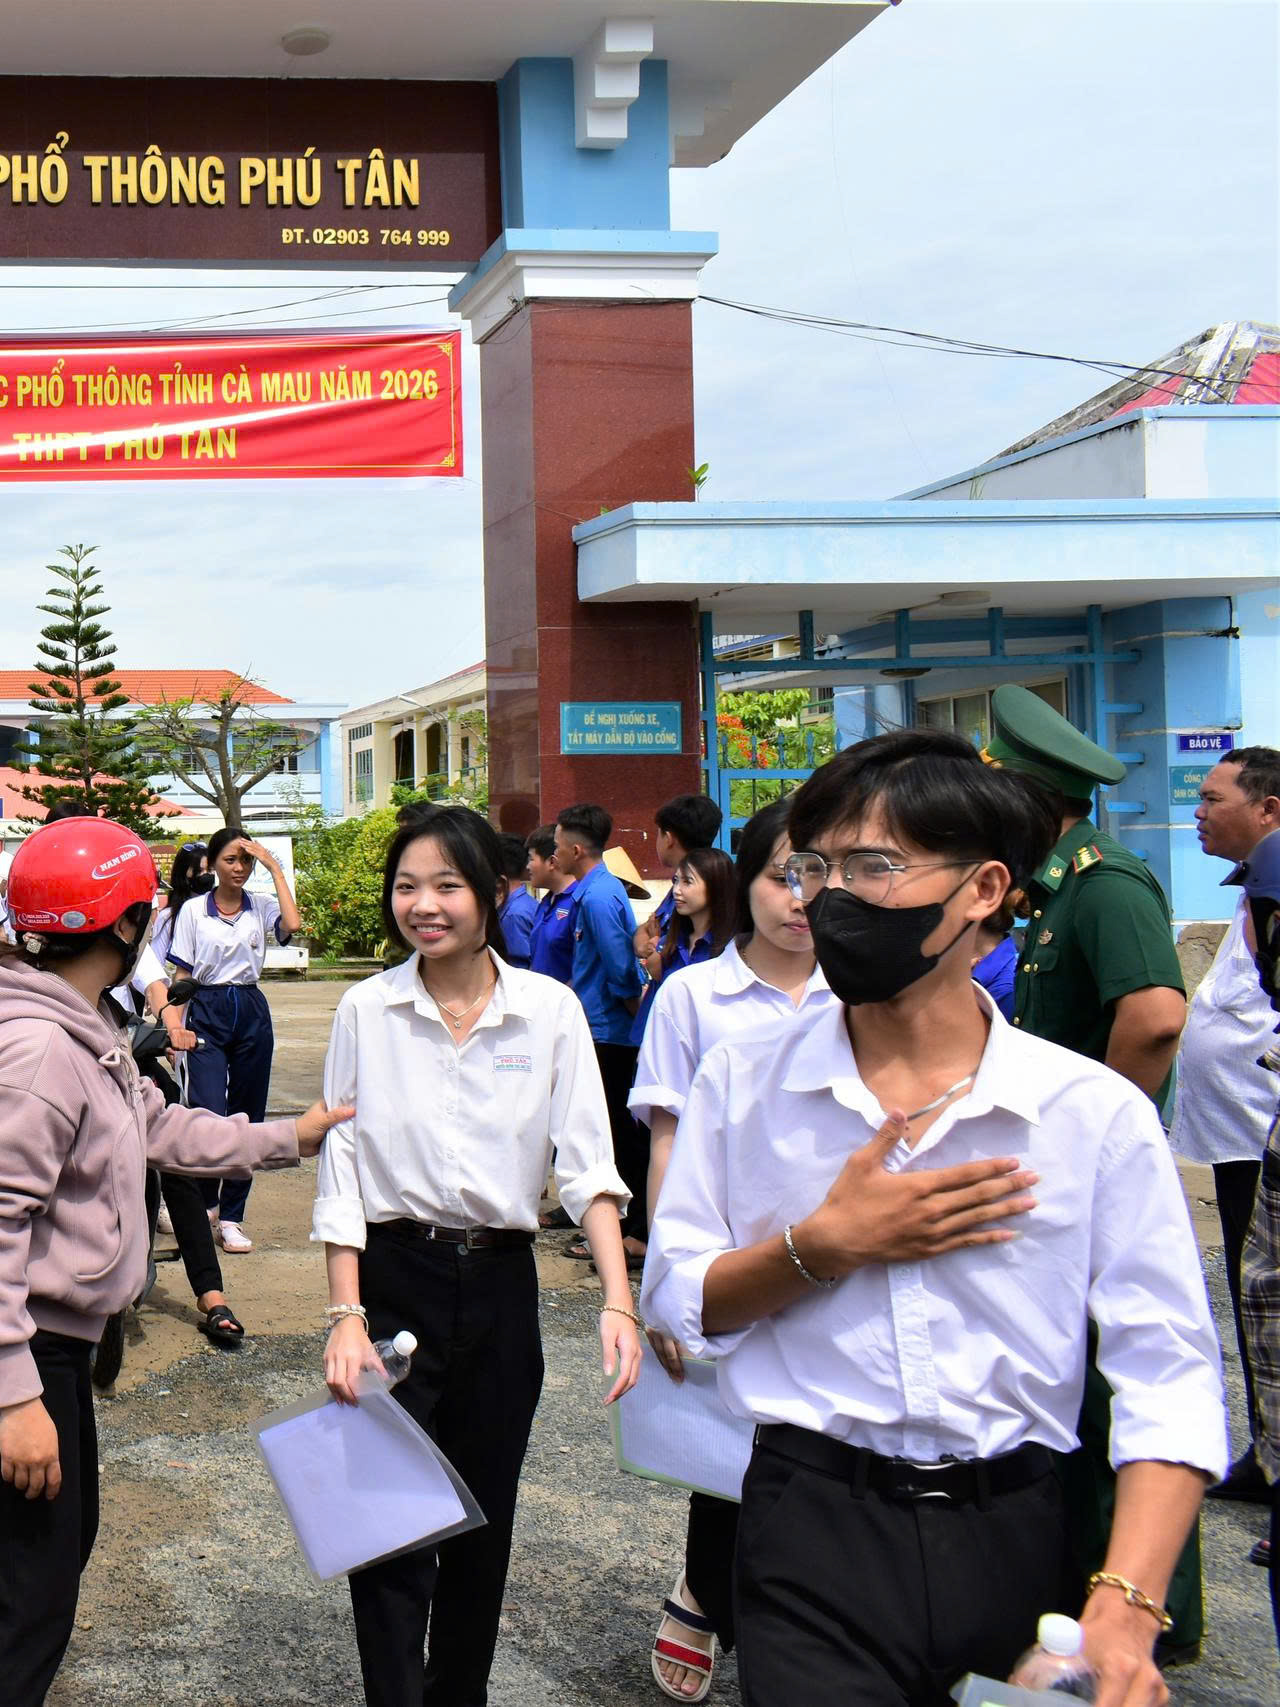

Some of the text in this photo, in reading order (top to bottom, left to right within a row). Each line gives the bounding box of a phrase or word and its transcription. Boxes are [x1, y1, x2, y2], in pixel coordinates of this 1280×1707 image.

[83, 144, 226, 206] THÔNG
[239, 147, 322, 207] PHÚ
[336, 148, 420, 207] TÂN
[379, 229, 413, 246] 764
[416, 230, 450, 247] 999
[16, 357, 65, 408] PHỔ
[71, 365, 153, 407] THÔNG
[158, 361, 214, 406] TỈNH
[221, 364, 253, 404] CÀ
[261, 370, 312, 403] MAU
[320, 365, 373, 402] NĂM
[379, 368, 439, 401] 2026
[12, 430, 92, 463] THPT
[104, 421, 164, 461] PHÚ
[1189, 735, 1222, 749] BẢO VỆ
